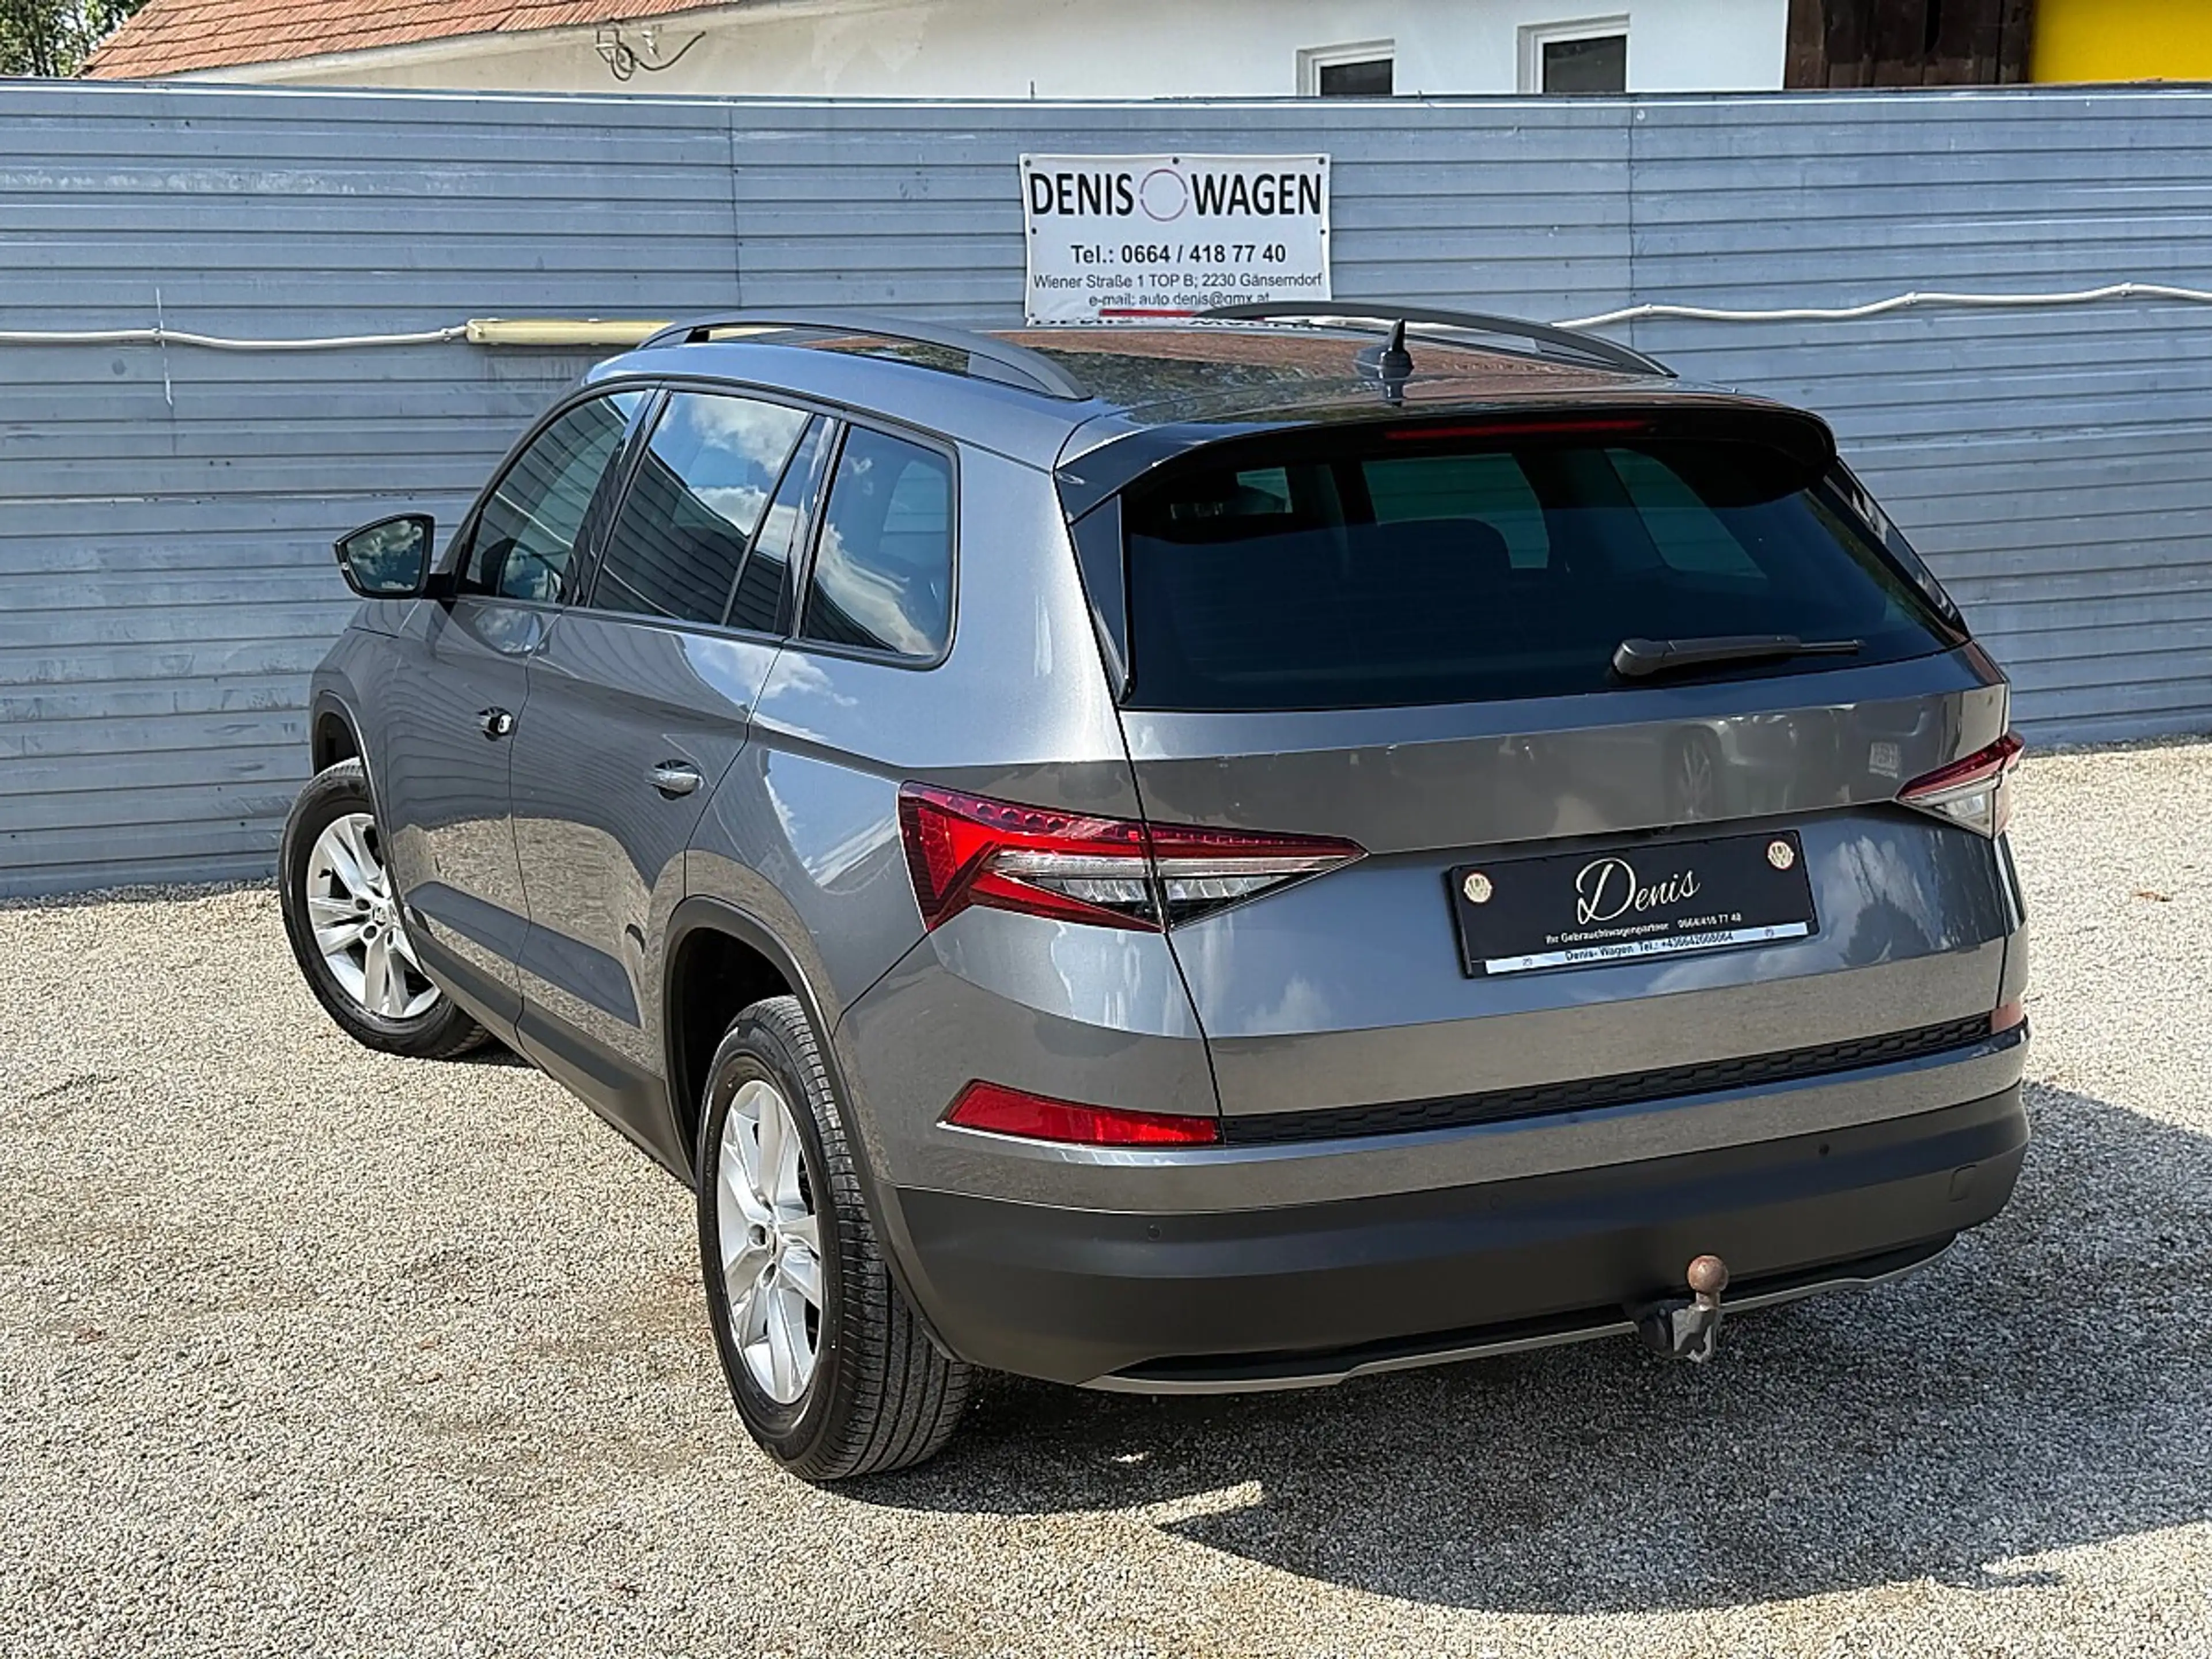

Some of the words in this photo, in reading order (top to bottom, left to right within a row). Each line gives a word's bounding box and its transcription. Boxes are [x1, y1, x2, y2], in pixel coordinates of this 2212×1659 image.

[1030, 173, 1134, 215] DENIS
[1191, 174, 1321, 215] WAGEN
[1071, 245, 1113, 263] Tel.:
[1122, 245, 1171, 263] 0664
[1176, 245, 1184, 263] /
[1190, 245, 1226, 263] 418
[1233, 245, 1256, 263] 77
[1263, 245, 1286, 263] 40
[1034, 275, 1082, 289] Wiener
[1086, 274, 1132, 288] Straße
[1138, 275, 1144, 287] 1
[1148, 274, 1179, 287] TOP
[1202, 273, 1236, 287] 2230
[1575, 857, 1700, 925] Denis
